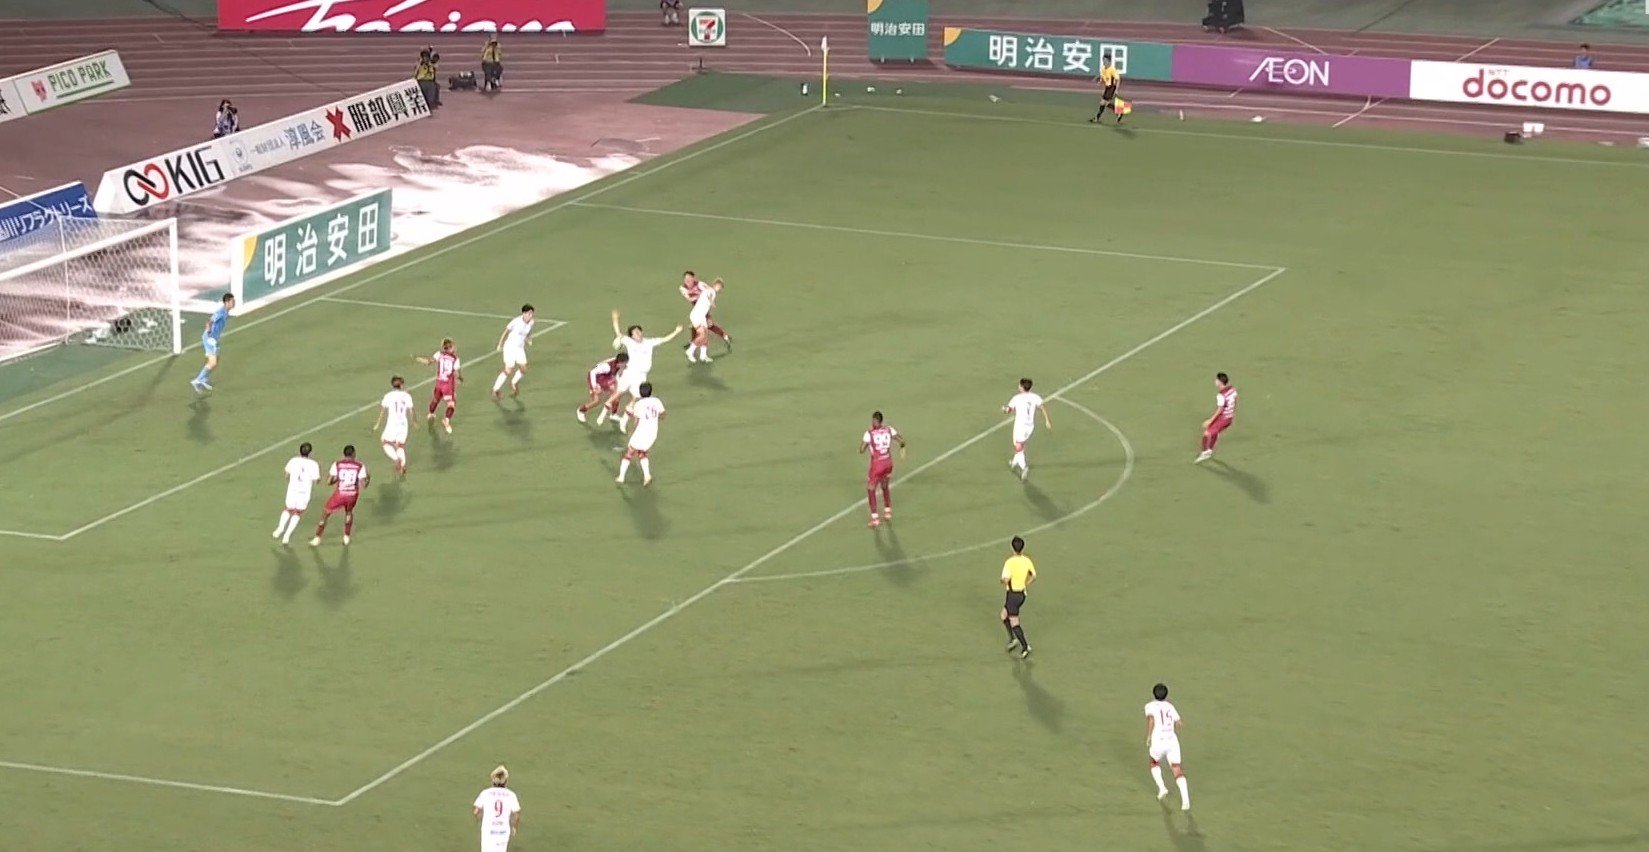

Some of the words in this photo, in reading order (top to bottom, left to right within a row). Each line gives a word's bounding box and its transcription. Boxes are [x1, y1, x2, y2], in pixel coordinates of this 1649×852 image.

[870, 22, 925, 36] 明治安田
[989, 35, 1128, 75] 明治安田
[47, 69, 78, 91] PICO
[77, 60, 113, 83] PARK
[1463, 68, 1611, 106] docomo
[347, 86, 428, 133] 服部興業
[164, 145, 225, 194] KIG
[264, 202, 379, 286] 明治安田
[494, 799, 503, 818] 9
